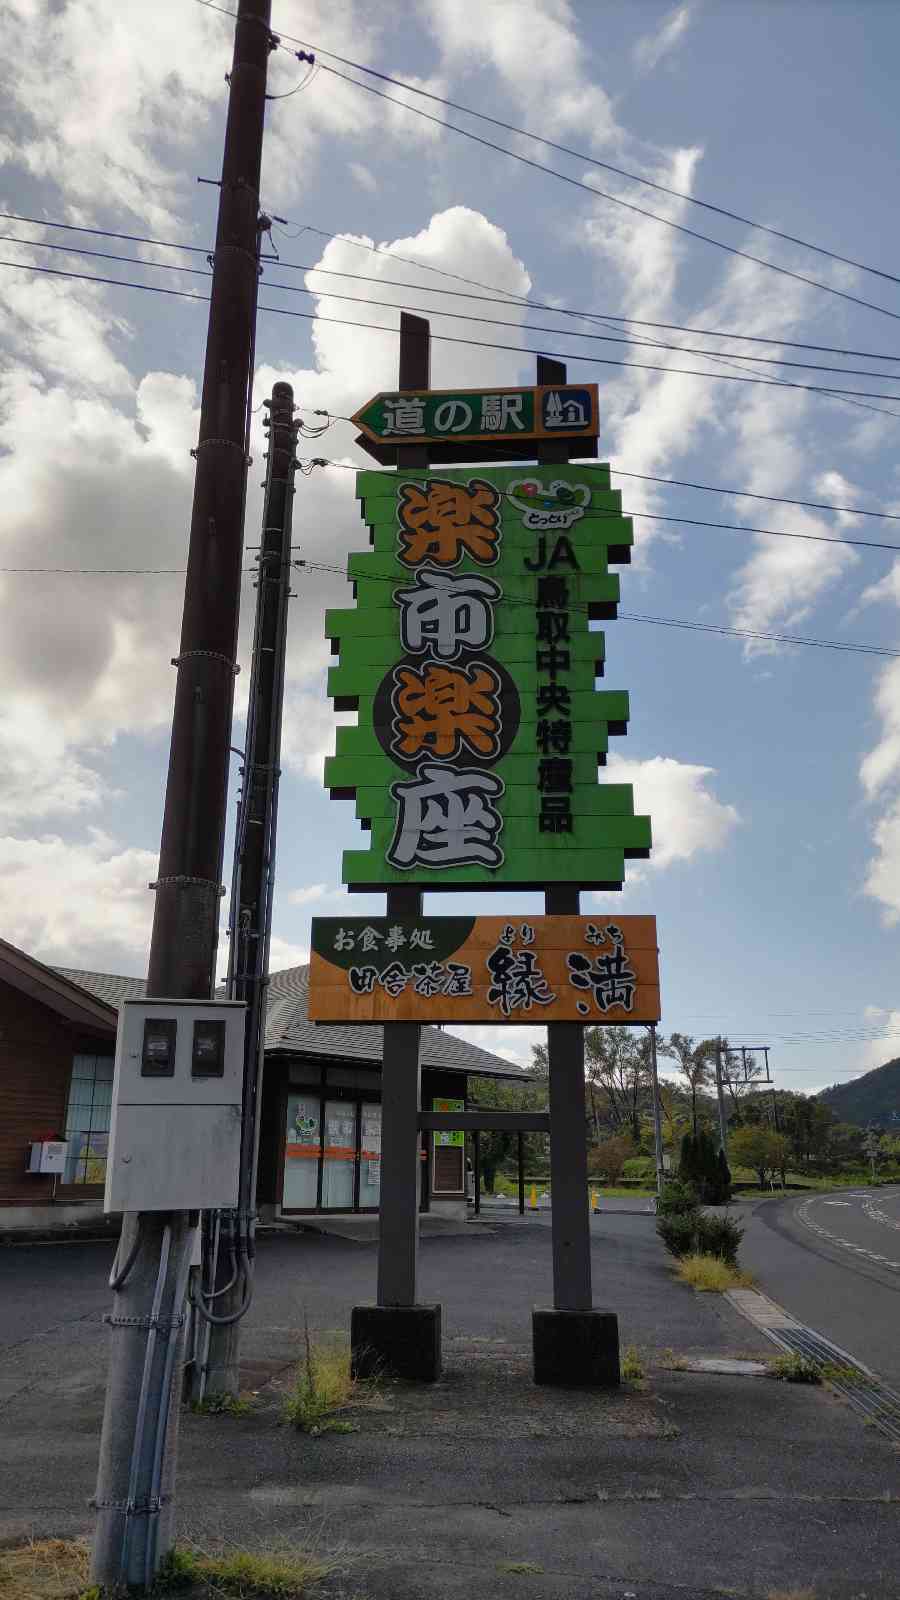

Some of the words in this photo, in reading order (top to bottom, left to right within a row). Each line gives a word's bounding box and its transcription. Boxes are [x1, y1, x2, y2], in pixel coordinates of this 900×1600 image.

[384, 395, 526, 435] 道の駅
[385, 477, 505, 869] 楽市楽座
[333, 926, 436, 952] お食事処
[350, 961, 475, 999] 田舎茶屋
